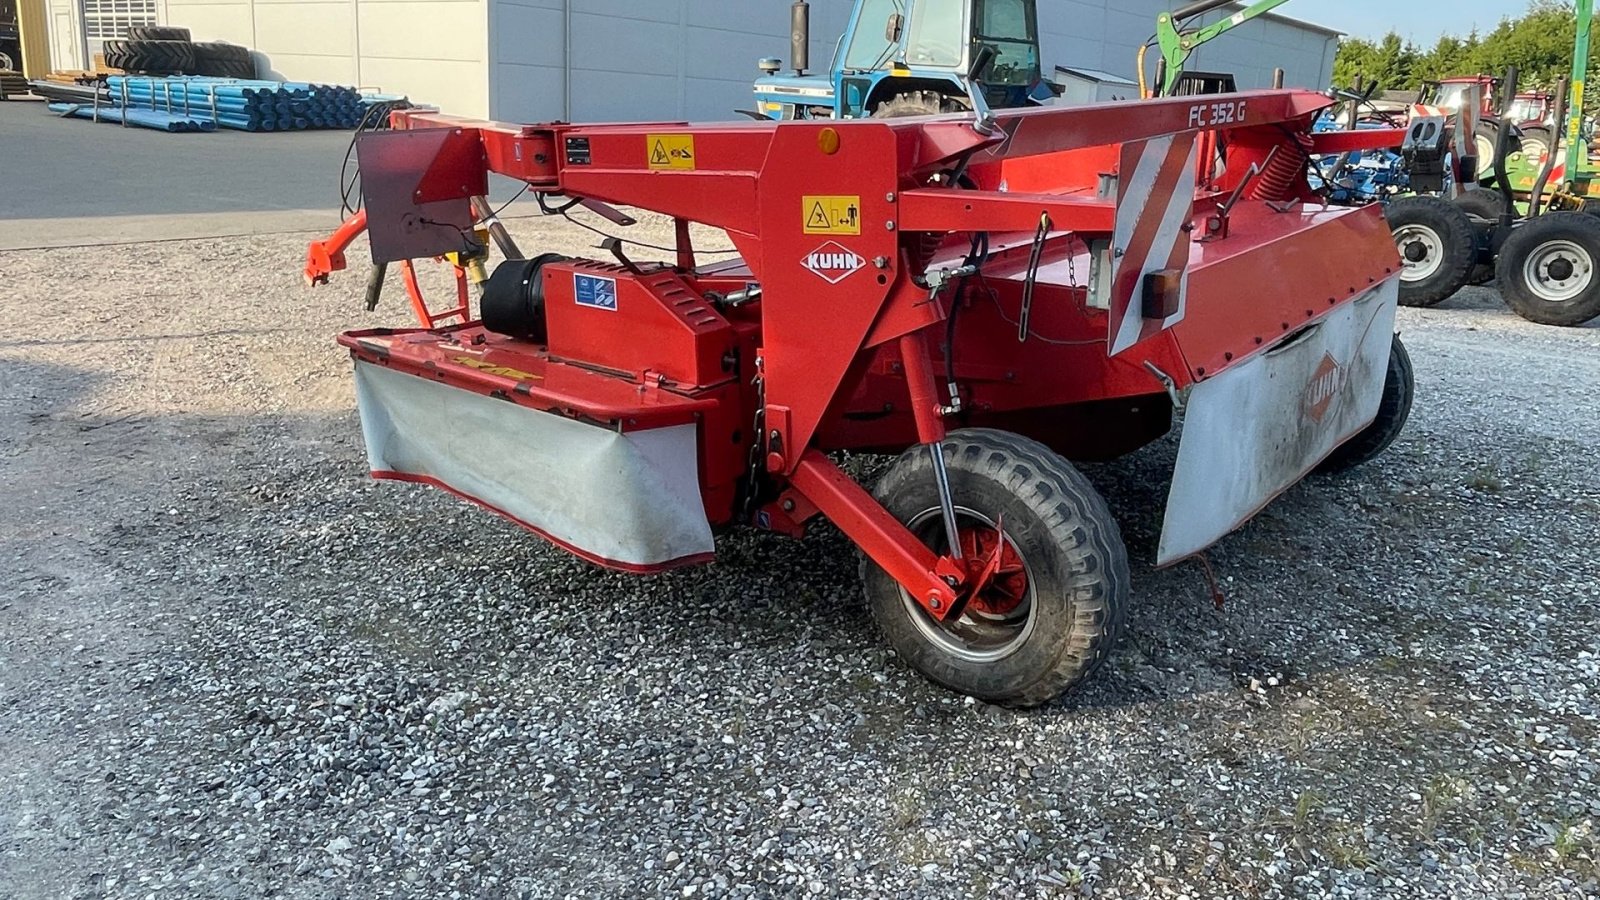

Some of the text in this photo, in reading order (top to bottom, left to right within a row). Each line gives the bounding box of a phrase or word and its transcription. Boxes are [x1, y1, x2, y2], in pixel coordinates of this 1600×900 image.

[1189, 101, 1246, 128] FC 352 G
[807, 253, 858, 269] KUHN
